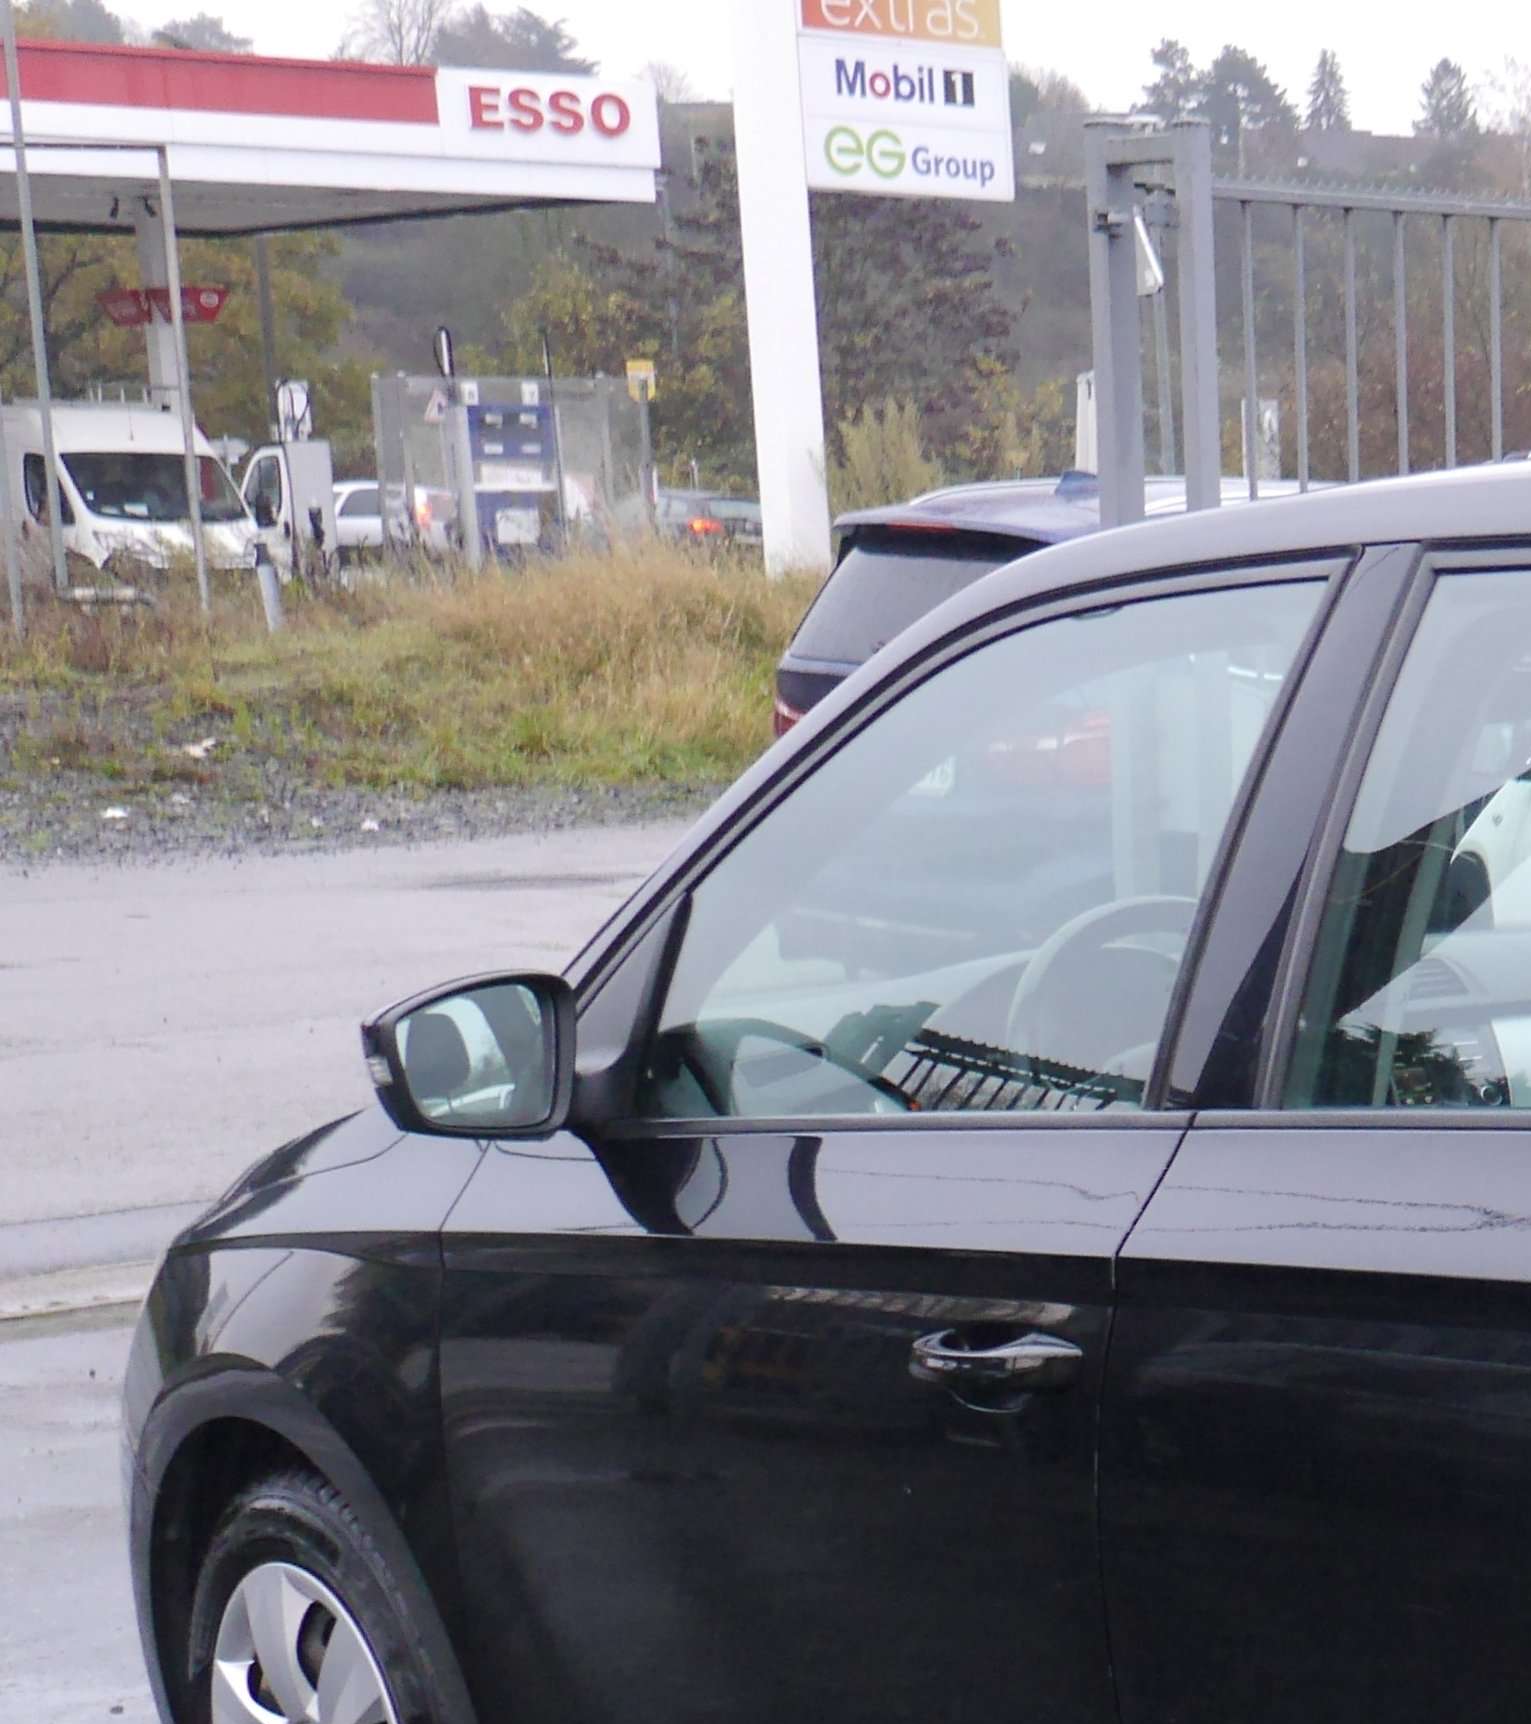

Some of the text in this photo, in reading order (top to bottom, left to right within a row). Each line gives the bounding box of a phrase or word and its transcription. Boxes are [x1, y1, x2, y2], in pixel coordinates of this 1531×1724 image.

[834, 58, 971, 107] Mobil 1
[467, 85, 631, 138] ESSO
[911, 146, 995, 187] Group
